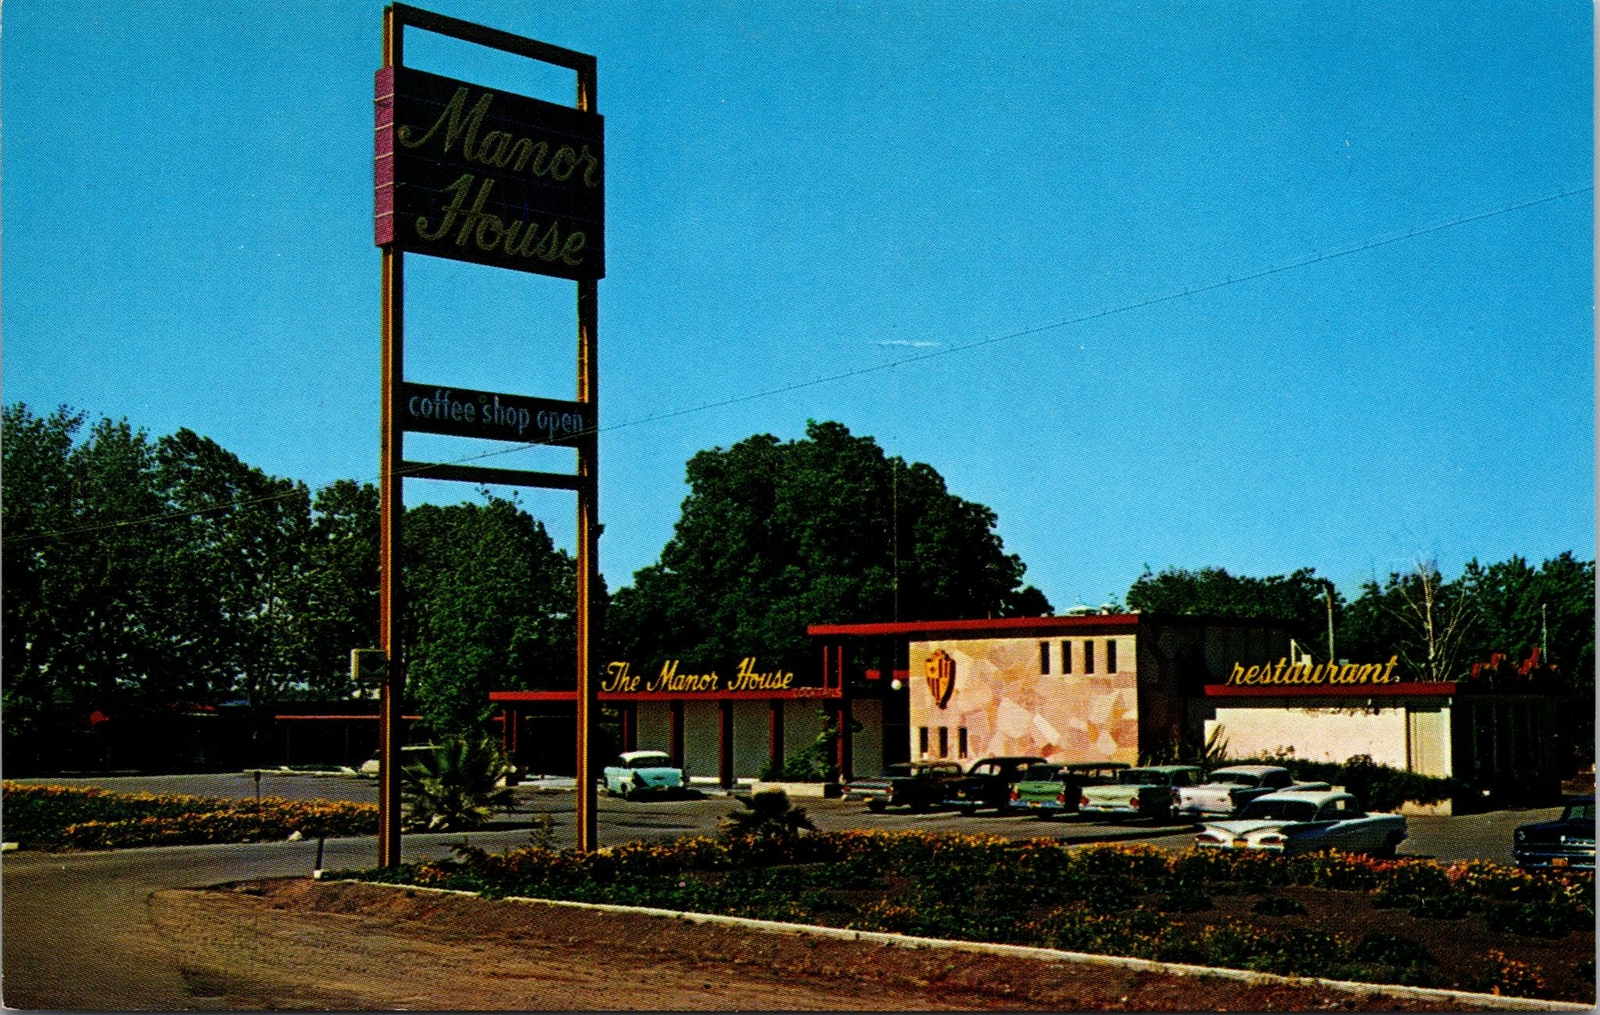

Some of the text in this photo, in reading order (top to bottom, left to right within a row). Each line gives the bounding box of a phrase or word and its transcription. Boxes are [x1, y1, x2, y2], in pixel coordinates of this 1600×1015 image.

[397, 86, 600, 188] Manor
[415, 173, 586, 266] House
[408, 388, 584, 442] coffee shop open
[601, 656, 794, 693] The Manor House
[1225, 654, 1400, 686] restaurant
